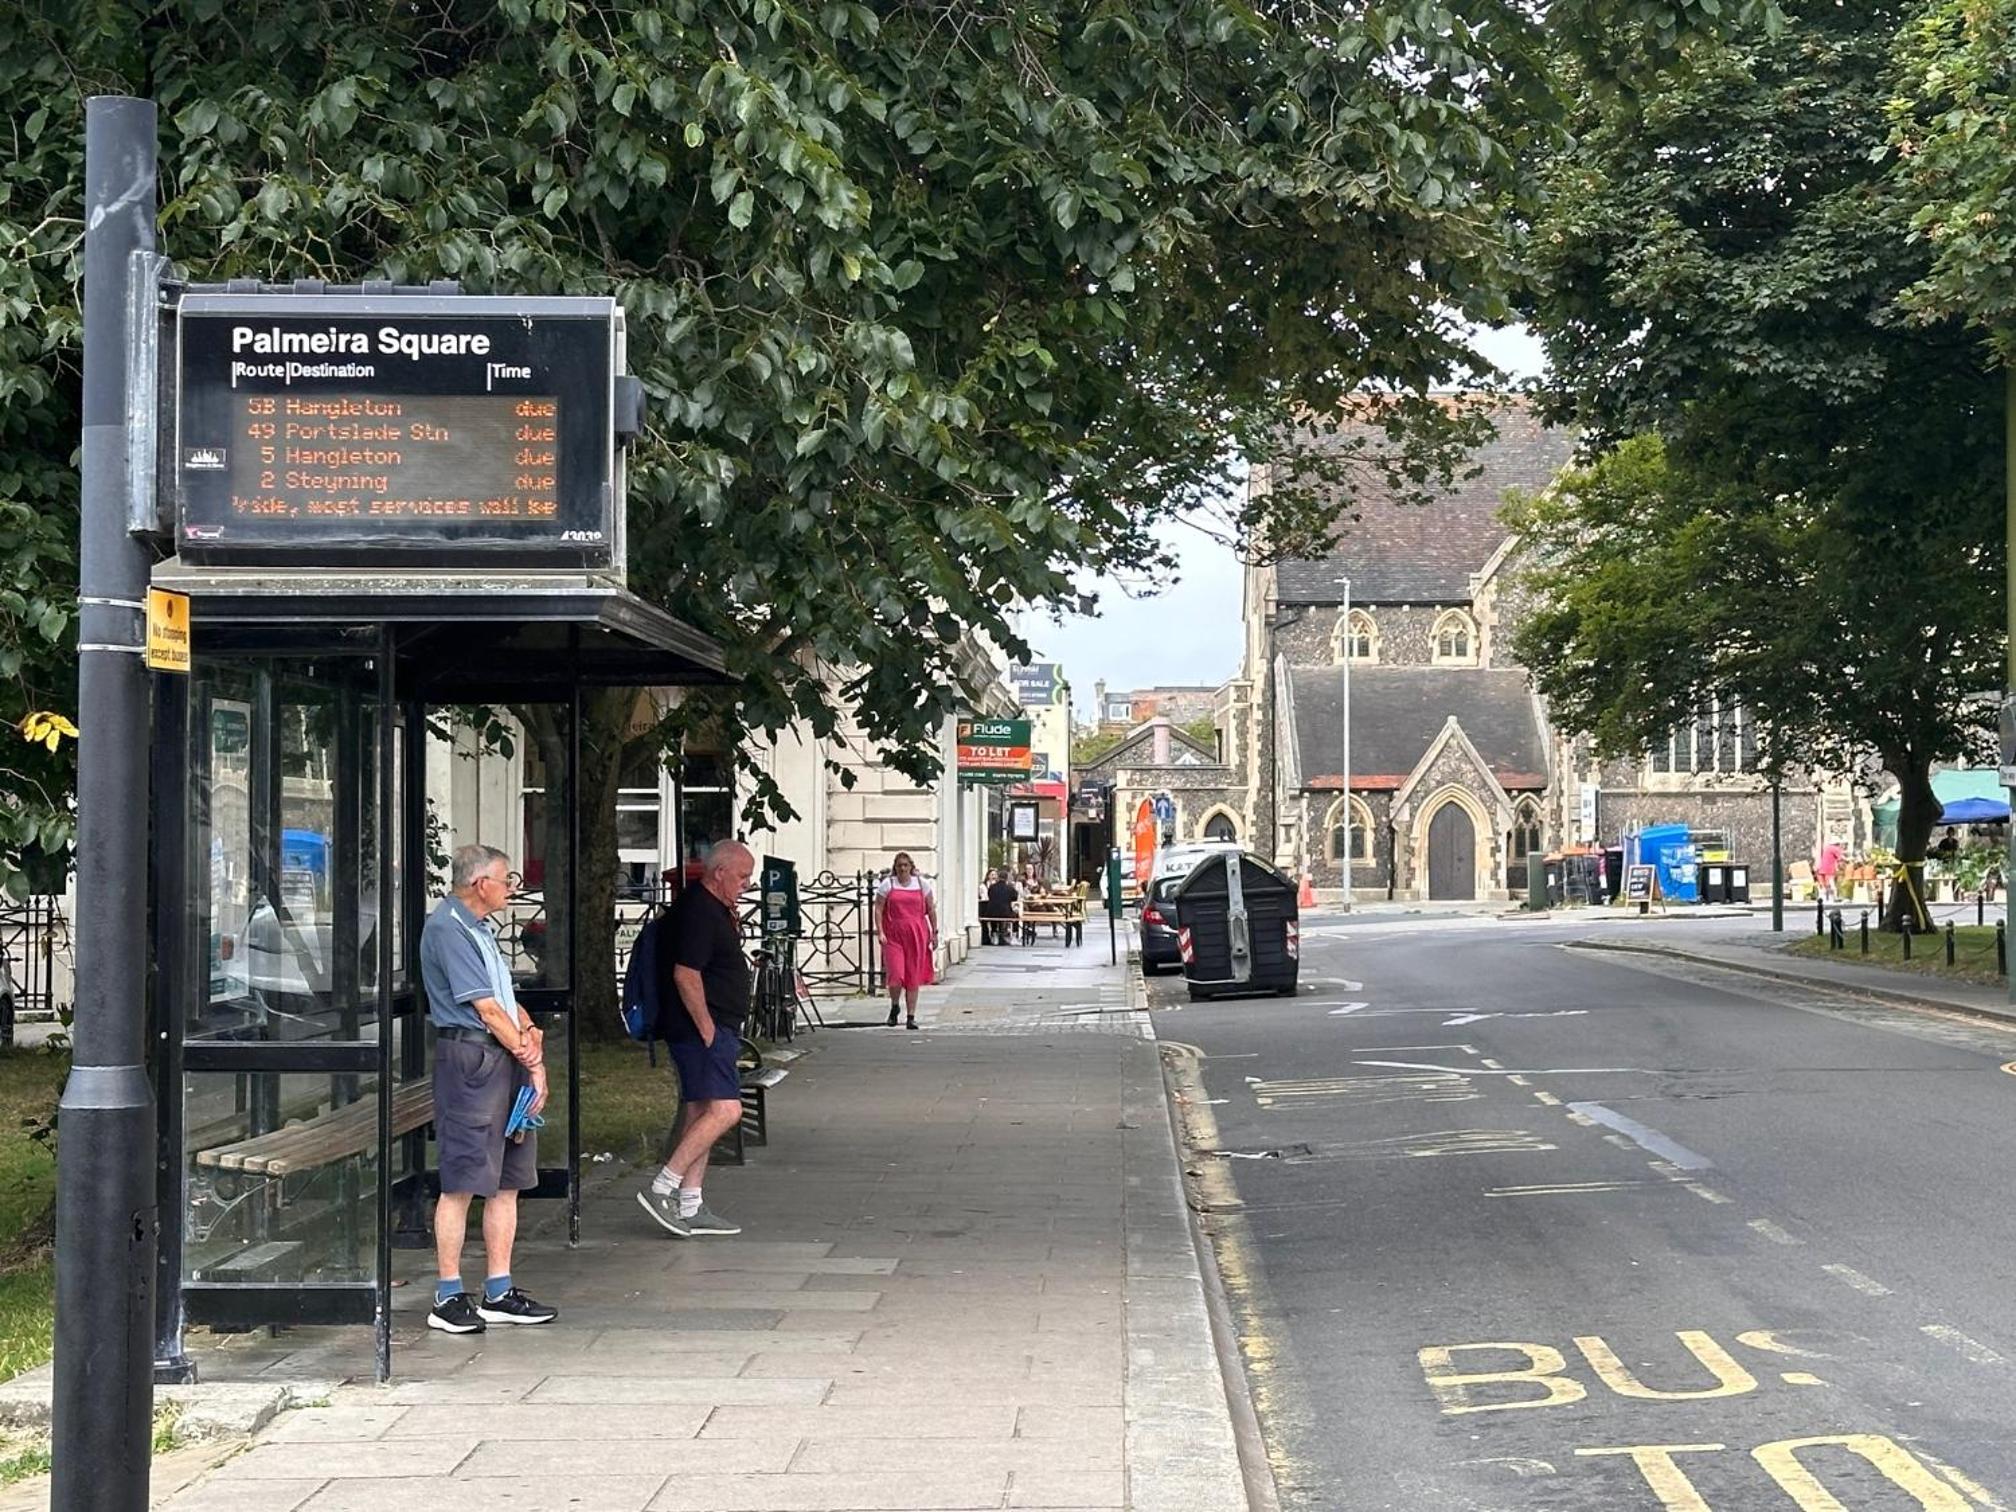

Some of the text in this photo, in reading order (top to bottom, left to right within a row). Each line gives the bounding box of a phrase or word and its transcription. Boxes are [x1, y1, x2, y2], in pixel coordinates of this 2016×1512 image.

[232, 326, 490, 361] Palmeira Square
[236, 361, 532, 379] Route Destination Time
[248, 397, 557, 420] 5B Hangleton due
[248, 422, 556, 442] 49 Portslade Stn due
[260, 446, 556, 469] 5 Hangleton due
[260, 470, 556, 494] 2 Steyning due
[368, 496, 471, 515] services
[973, 723, 1012, 735] Flude
[970, 747, 1012, 757] TO LET
[769, 869, 781, 887] P
